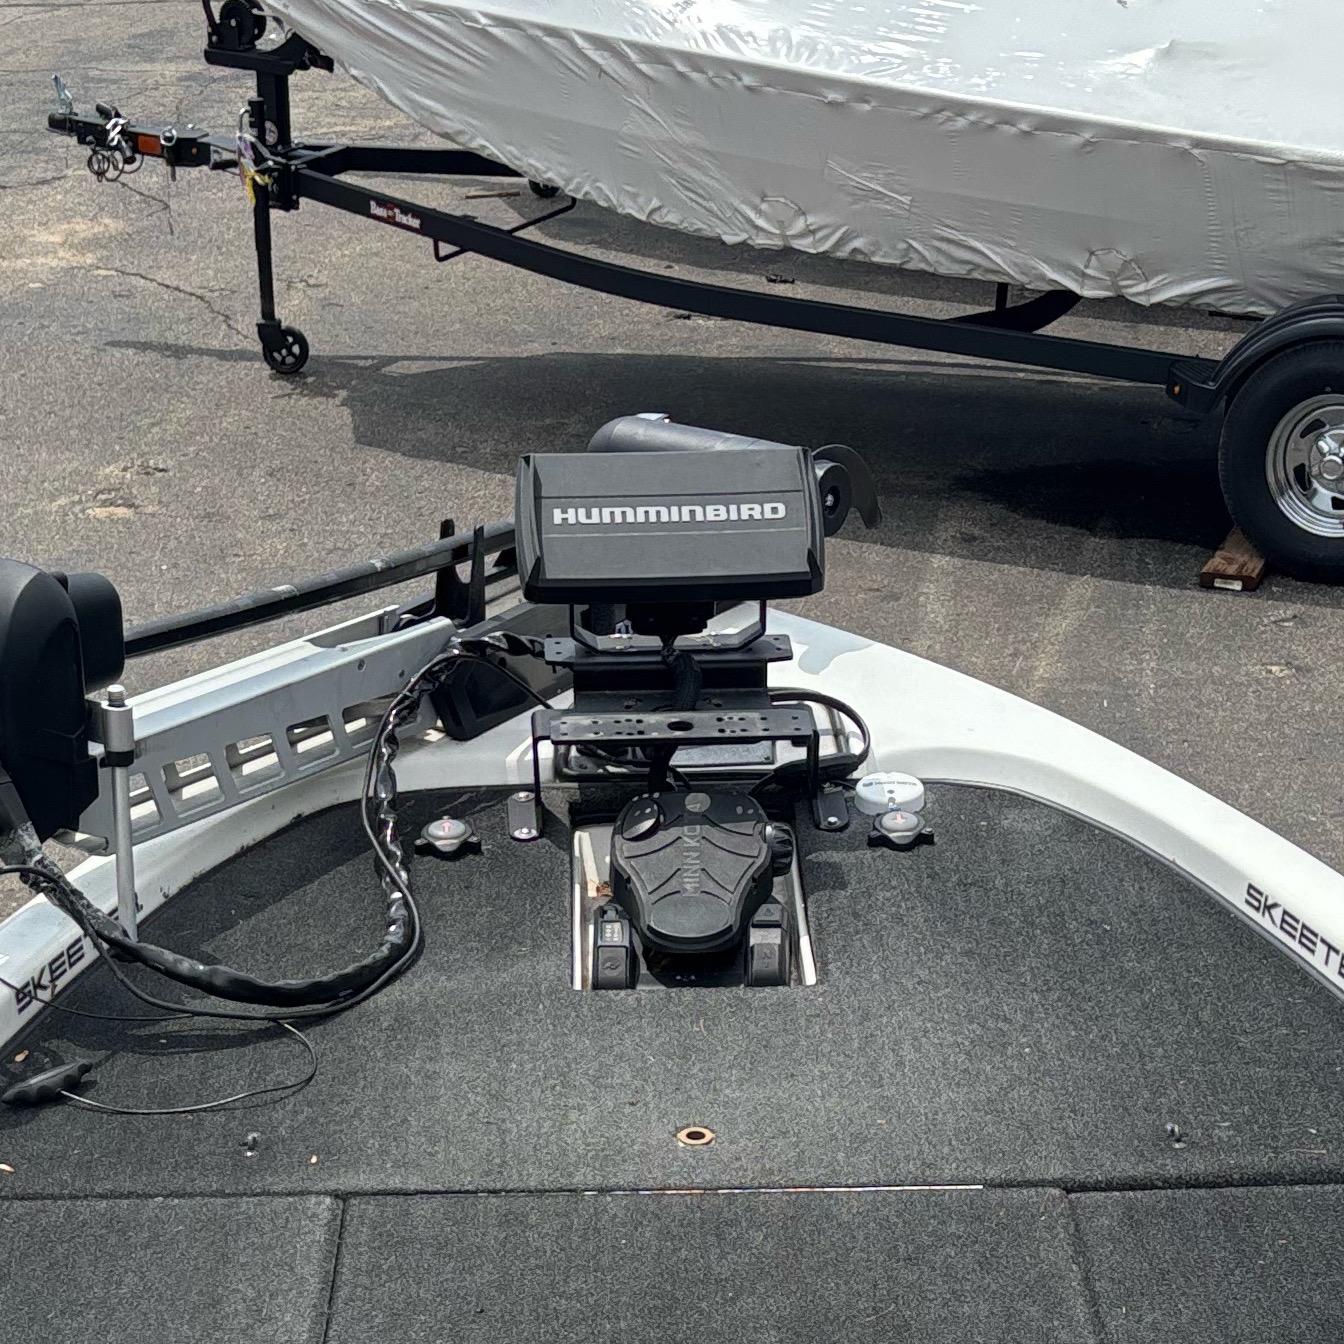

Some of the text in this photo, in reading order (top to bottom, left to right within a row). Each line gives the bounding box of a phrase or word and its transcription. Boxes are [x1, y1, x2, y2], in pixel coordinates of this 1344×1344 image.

[553, 502, 787, 525] HUMMINBIRD
[682, 803, 701, 897] MINN KOA
[15, 928, 92, 1016] SKEE
